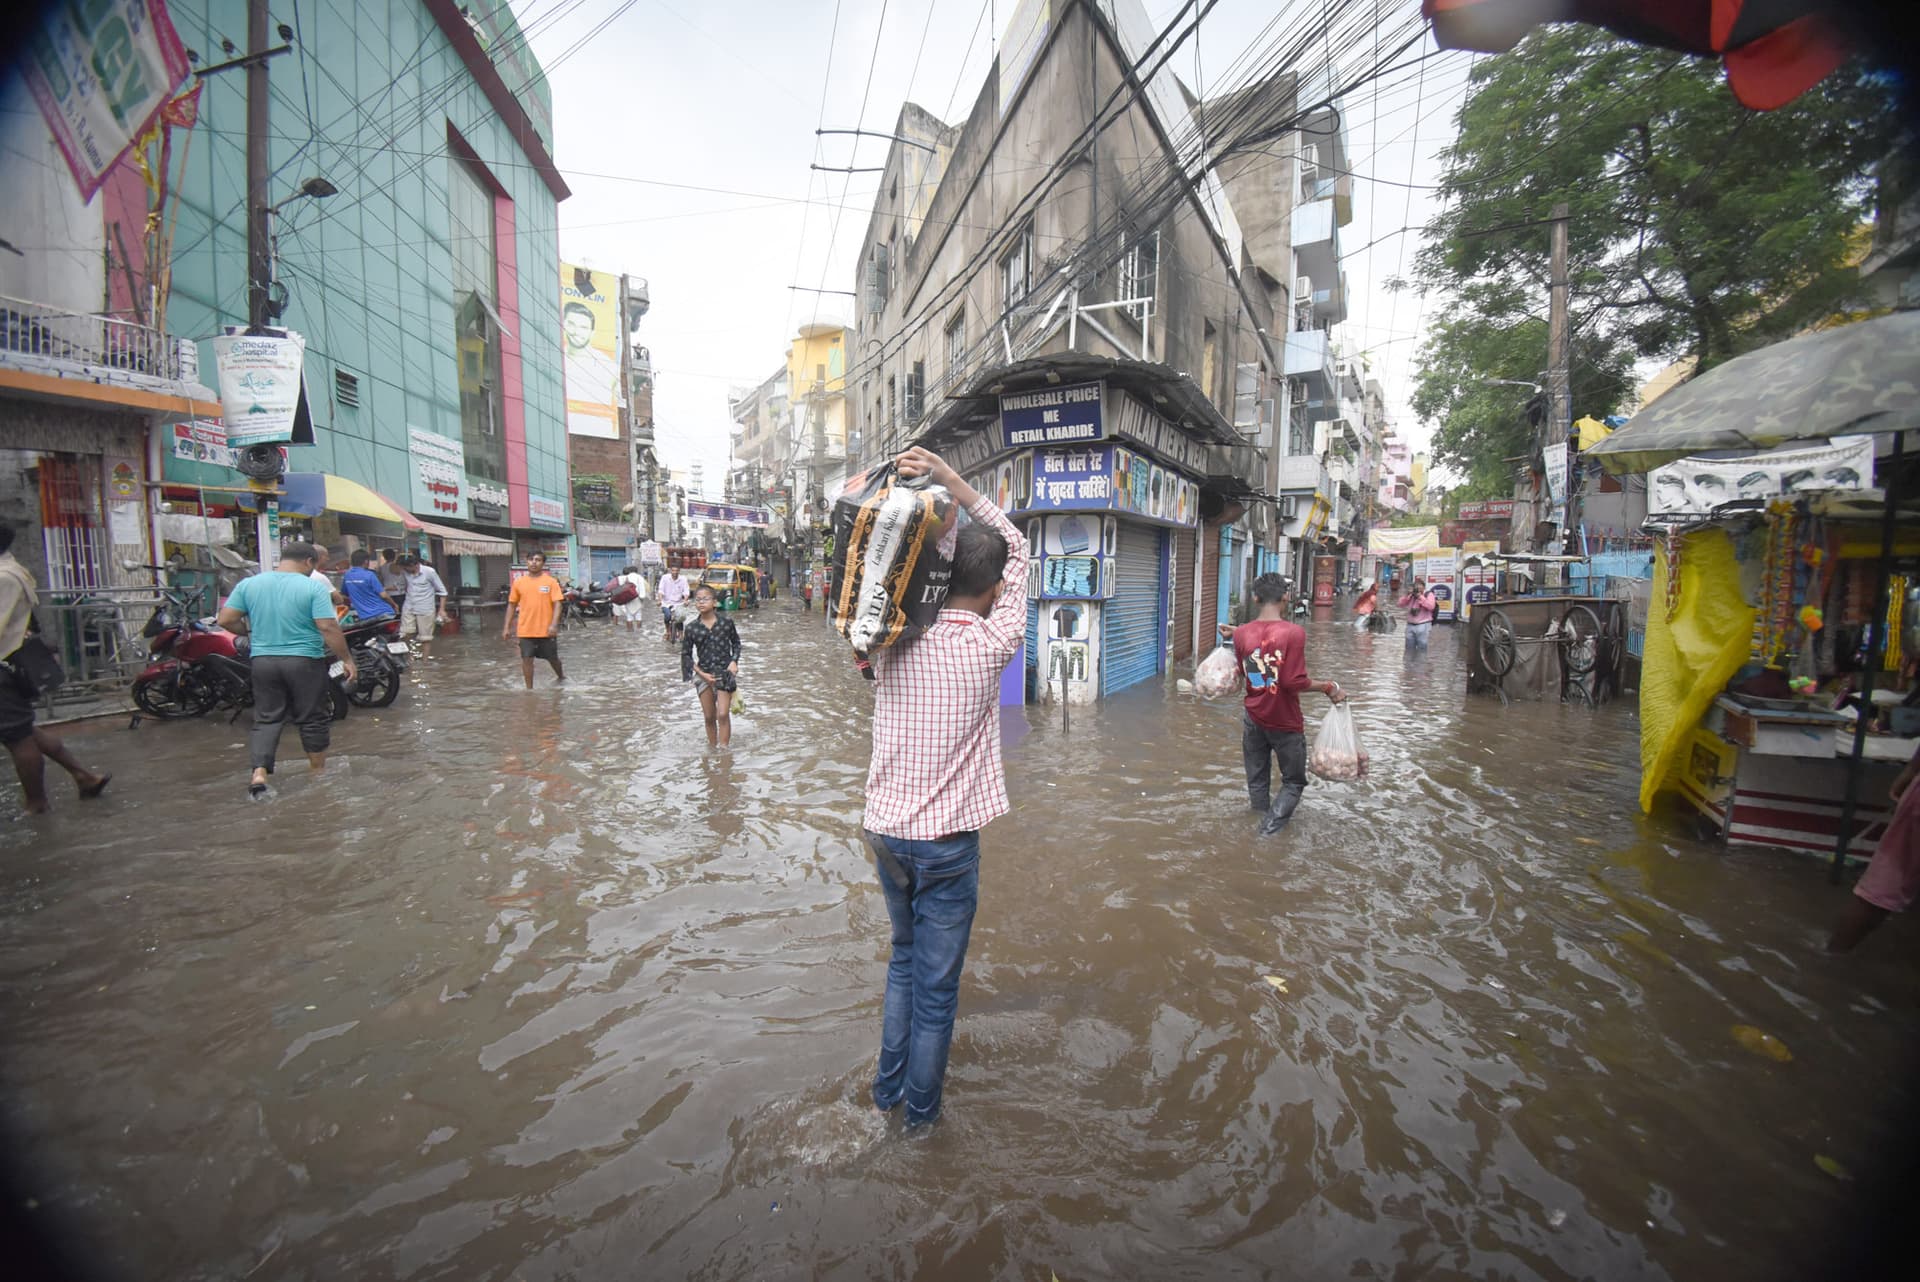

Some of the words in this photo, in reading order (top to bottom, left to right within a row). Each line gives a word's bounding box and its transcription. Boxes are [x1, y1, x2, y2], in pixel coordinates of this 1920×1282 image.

[1003, 391, 1063, 411] WHOLESALE
[1065, 386, 1100, 404] PRICE
[1043, 409, 1060, 424] ME
[1011, 428, 1045, 445] RETAIL
[1046, 423, 1095, 441] KHARIDE
[1120, 396, 1159, 448] MILAN
[1157, 421, 1187, 463] MEN'S
[1186, 439, 1209, 474] WEAR
[1067, 448, 1087, 472] सेल
[1087, 447, 1104, 471] रेट
[1035, 476, 1047, 500] में
[1048, 481, 1077, 506] खुदरा
